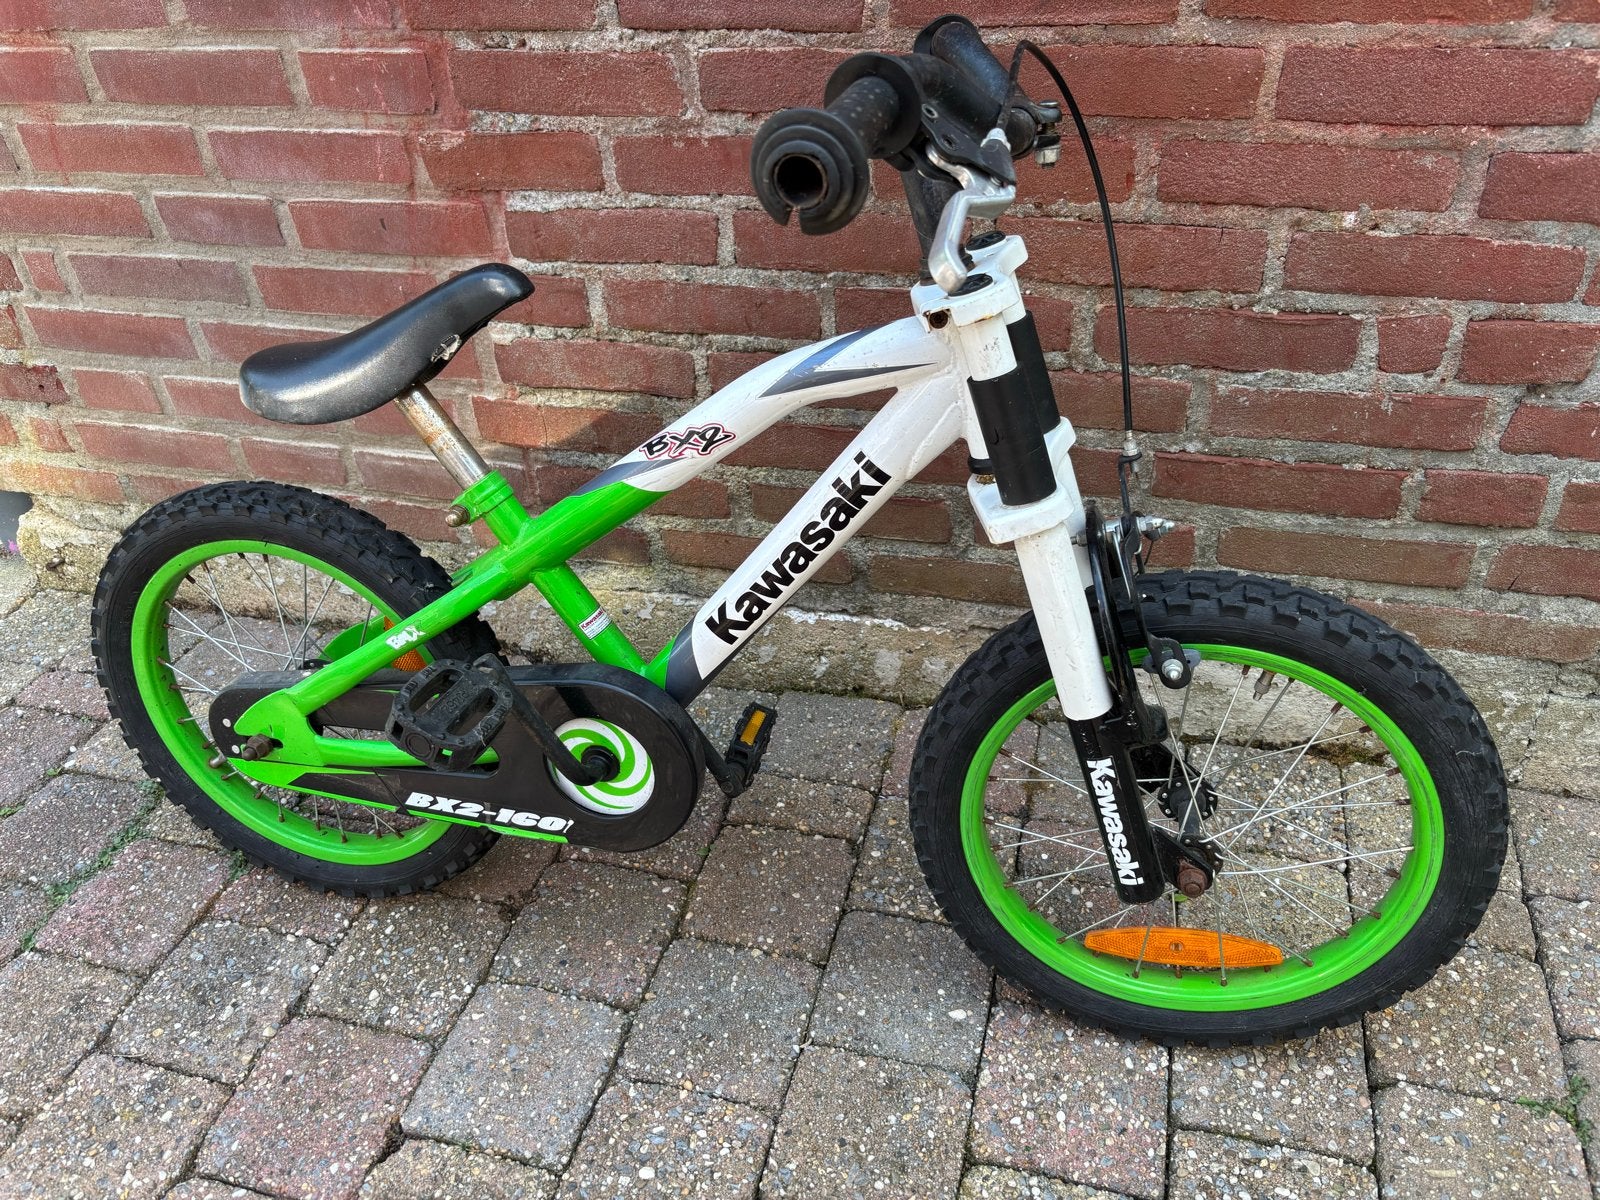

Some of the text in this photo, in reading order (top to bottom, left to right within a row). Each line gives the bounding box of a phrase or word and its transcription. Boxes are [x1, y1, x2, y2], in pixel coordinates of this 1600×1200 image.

[640, 424, 735, 459] BX2
[704, 450, 893, 645] Kawasaki
[1086, 757, 1145, 887] Kawasaki
